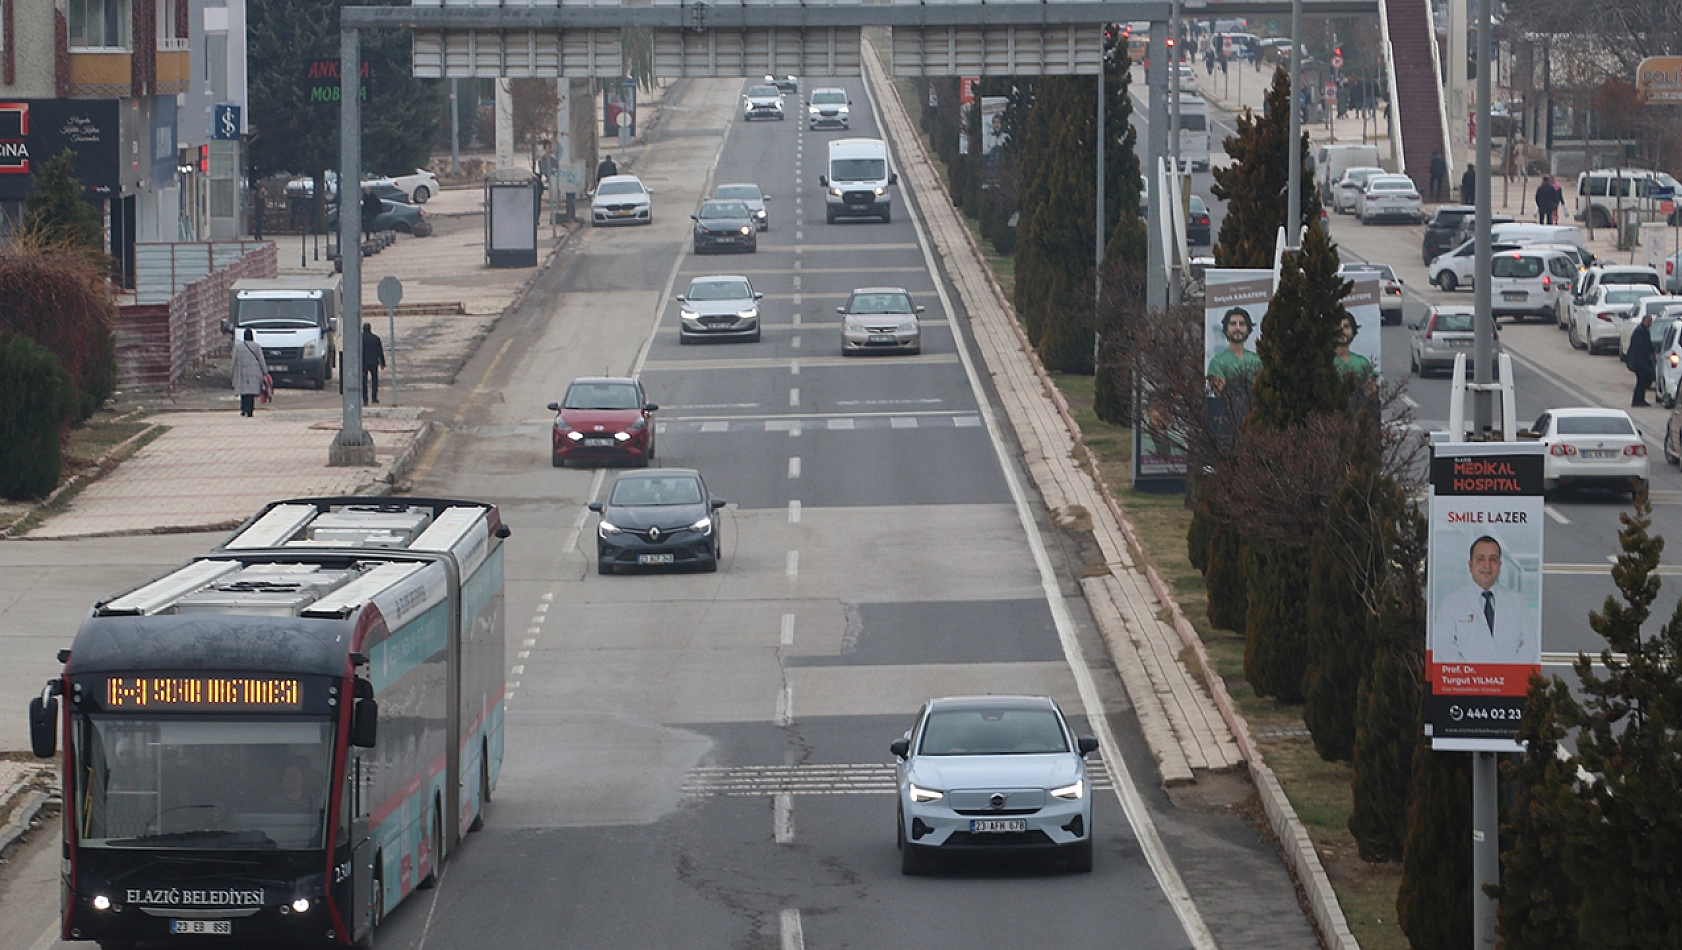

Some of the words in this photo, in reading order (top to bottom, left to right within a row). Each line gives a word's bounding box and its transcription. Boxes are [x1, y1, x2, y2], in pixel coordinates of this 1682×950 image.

[1453, 460, 1516, 475] MEDİKAL
[1453, 478, 1522, 491] HOSPITAL
[1448, 511, 1484, 523] SMILE
[1488, 511, 1528, 523] LAZER
[1442, 665, 1462, 674] Prof.
[1464, 665, 1476, 674] Dr.
[1442, 676, 1471, 686] Turgut
[1472, 676, 1505, 686] YILMAZ
[1466, 707, 1488, 719] 444
[1490, 707, 1506, 719] 02
[1507, 707, 1522, 719] 23
[976, 820, 986, 831] 23
[990, 820, 1005, 831] AFH
[126, 887, 178, 904] ELAZIĞ
[181, 887, 265, 905] BELEDİYESİ
[177, 921, 188, 932] 23
